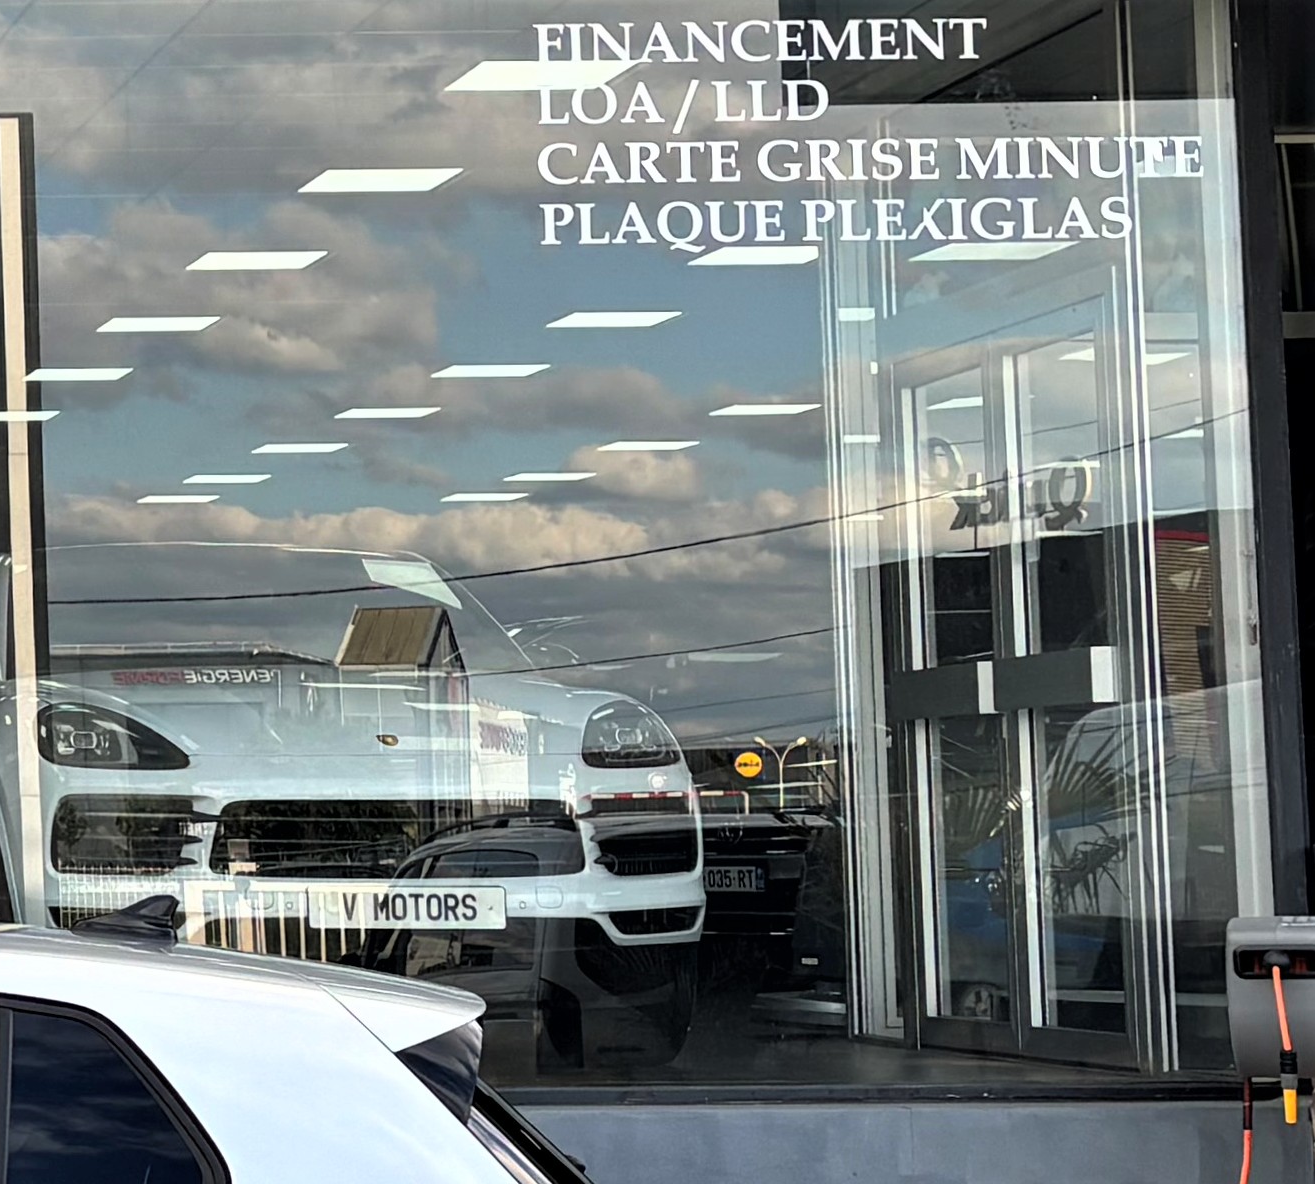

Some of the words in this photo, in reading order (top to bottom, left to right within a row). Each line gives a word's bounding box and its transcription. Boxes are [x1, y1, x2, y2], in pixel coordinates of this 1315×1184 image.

[533, 17, 988, 63] FINANCEMENT
[537, 141, 741, 185] CARTE
[757, 138, 939, 182] GRISE
[955, 136, 1204, 180] MINUTE
[539, 200, 785, 252] PLAQUE
[800, 196, 1132, 241] PLEXIGLAS
[342, 892, 358, 921] V
[374, 892, 478, 922] MOTORS
